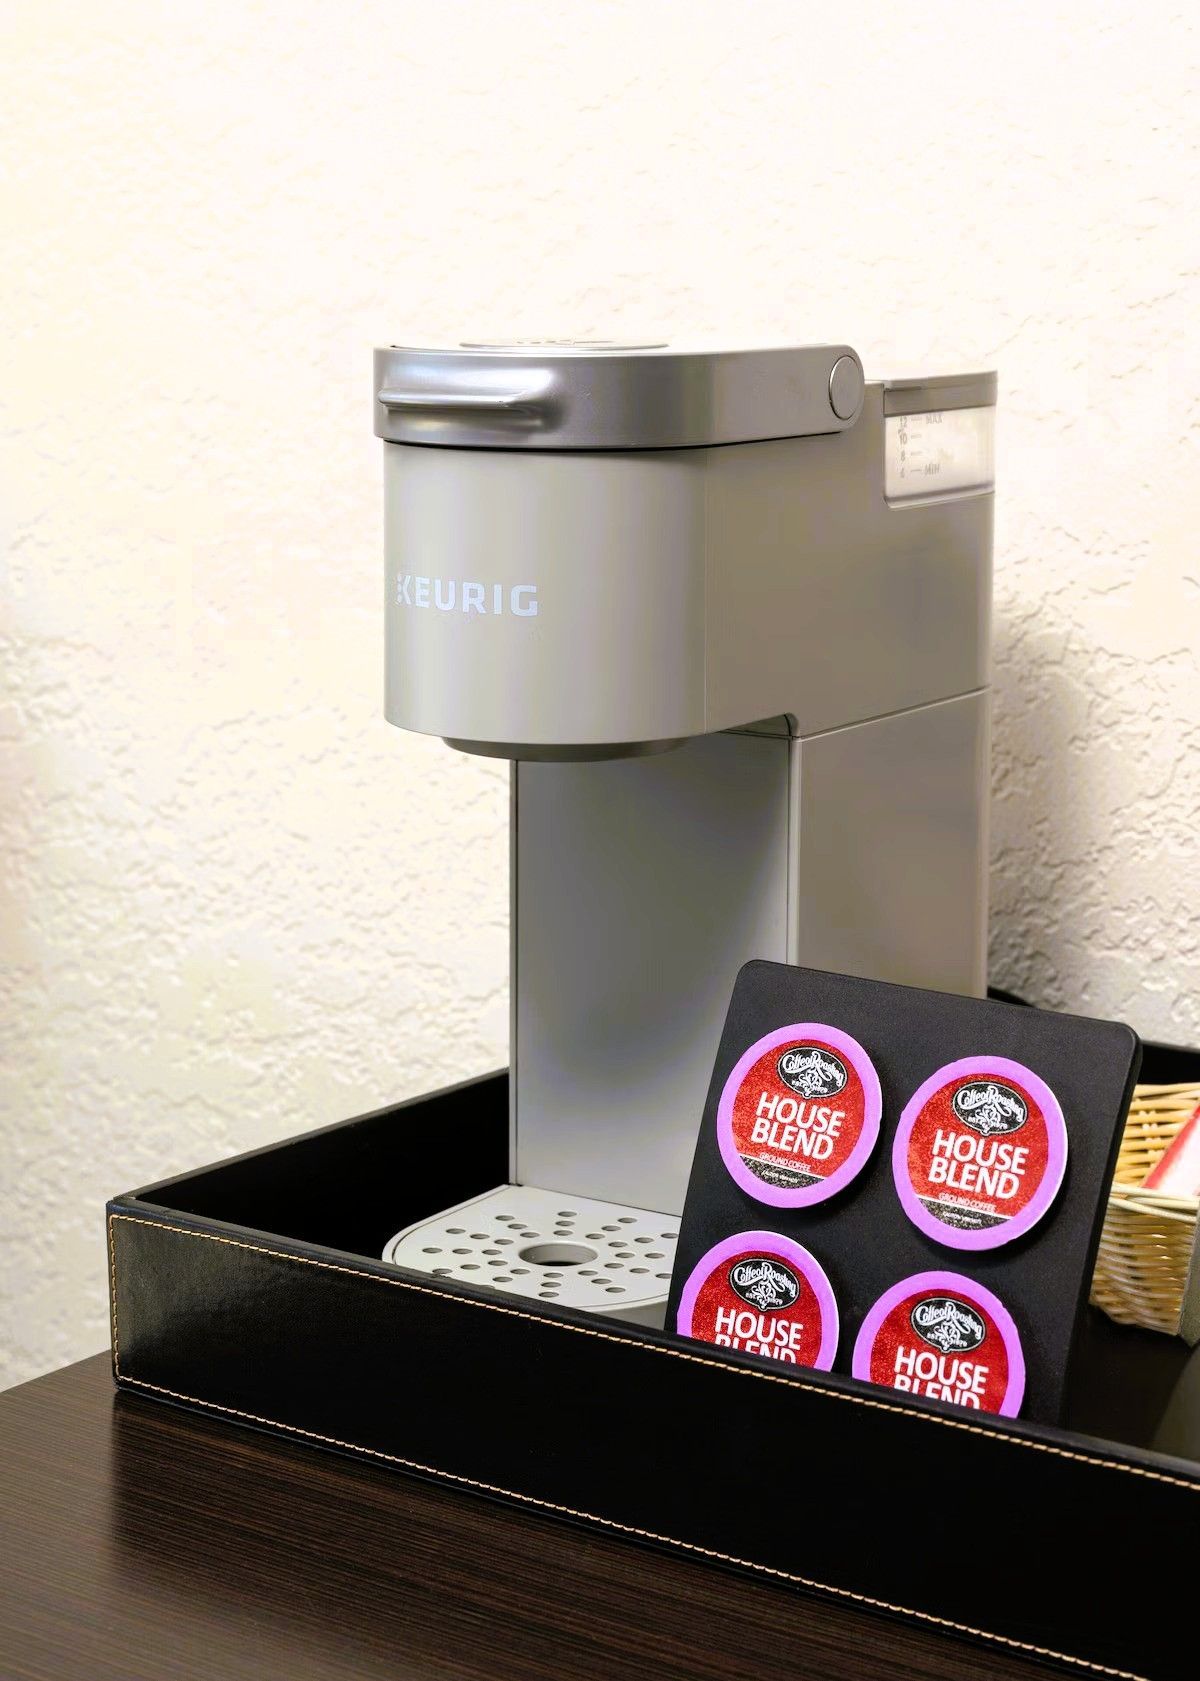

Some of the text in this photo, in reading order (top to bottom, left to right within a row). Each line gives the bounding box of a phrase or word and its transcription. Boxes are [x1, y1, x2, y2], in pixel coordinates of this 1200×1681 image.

[396, 574, 538, 617] KEURIG
[755, 1091, 846, 1138] HOUSE
[750, 1117, 835, 1161] BLEND
[931, 1128, 1030, 1176] HOUSE
[759, 1152, 812, 1174] GROUND COFFEE
[927, 1157, 1020, 1200] BLEND
[938, 1192, 997, 1214] GROUND COFFEE
[714, 1306, 804, 1351] HOUSE
[894, 1345, 989, 1395] HOUSE
